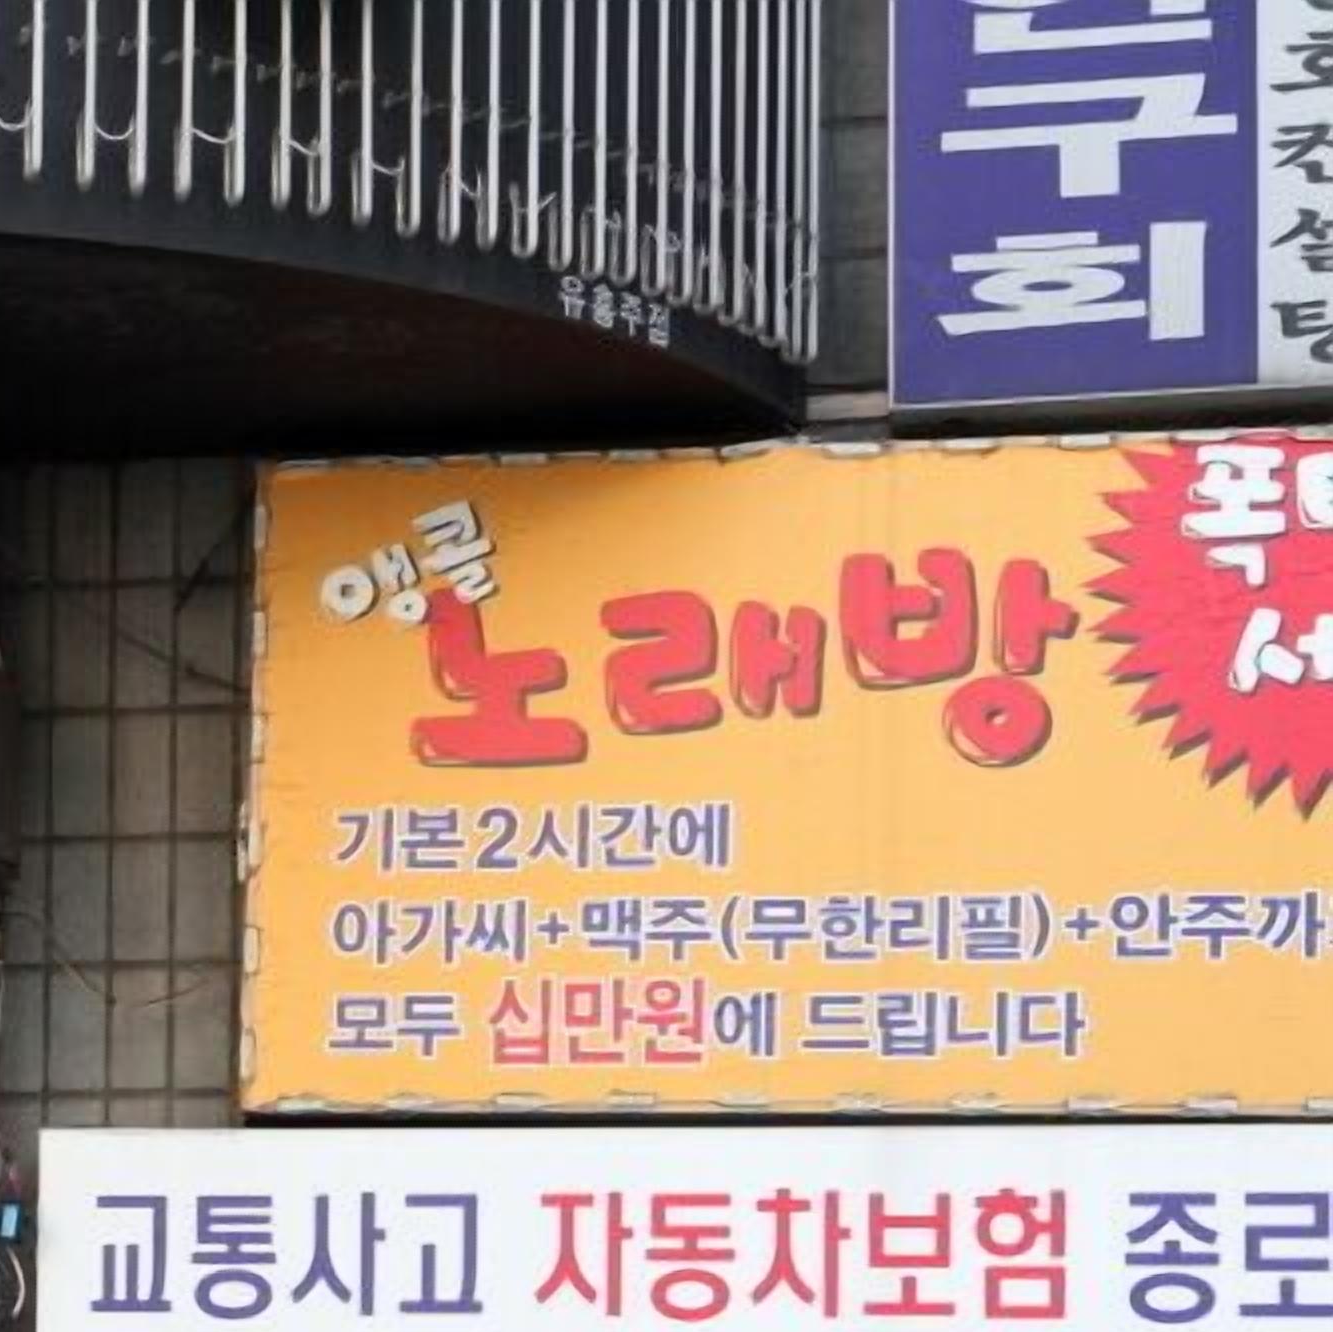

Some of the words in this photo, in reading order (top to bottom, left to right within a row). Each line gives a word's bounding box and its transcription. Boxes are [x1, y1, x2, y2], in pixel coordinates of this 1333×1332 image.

[409, 547, 1083, 770] 노래방
[335, 802, 732, 871] 기본2시간에
[329, 994, 460, 1057] 모두
[489, 977, 777, 1065] 십만원에
[800, 990, 1086, 1058] 드립니다
[90, 1190, 485, 1321] 교통사고
[536, 1187, 1069, 1322] 자동차보험
[1124, 1191, 1333, 1324] 종로
